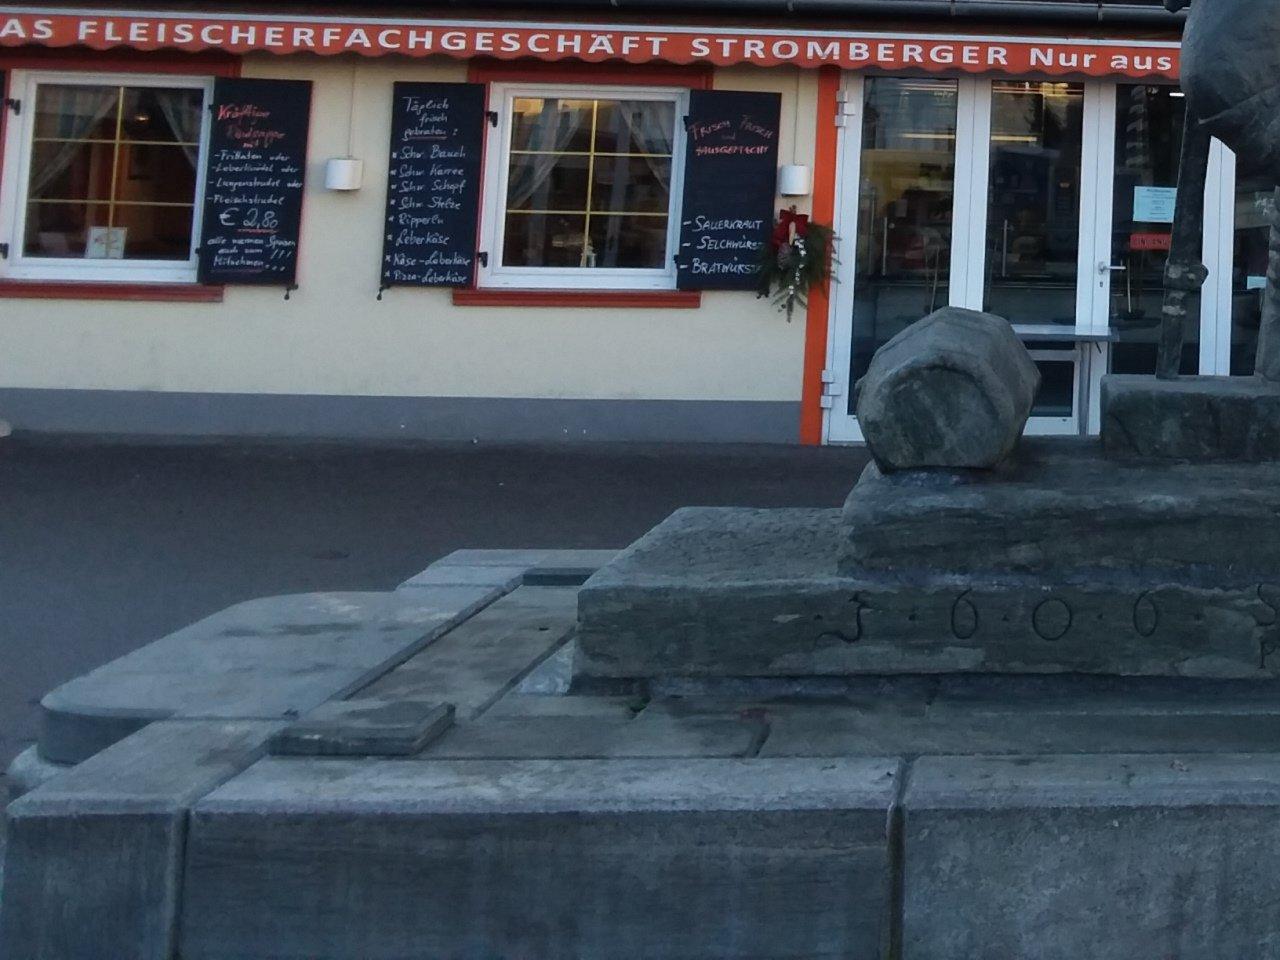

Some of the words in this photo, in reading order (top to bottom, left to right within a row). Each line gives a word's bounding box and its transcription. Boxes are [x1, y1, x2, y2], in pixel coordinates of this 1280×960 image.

[78, 20, 668, 56] FLEISCHERFACHGESCHÄFT
[691, 38, 1008, 65] STROMBERGER
[1030, 47, 1097, 68] Nur
[1110, 55, 1172, 71] aus
